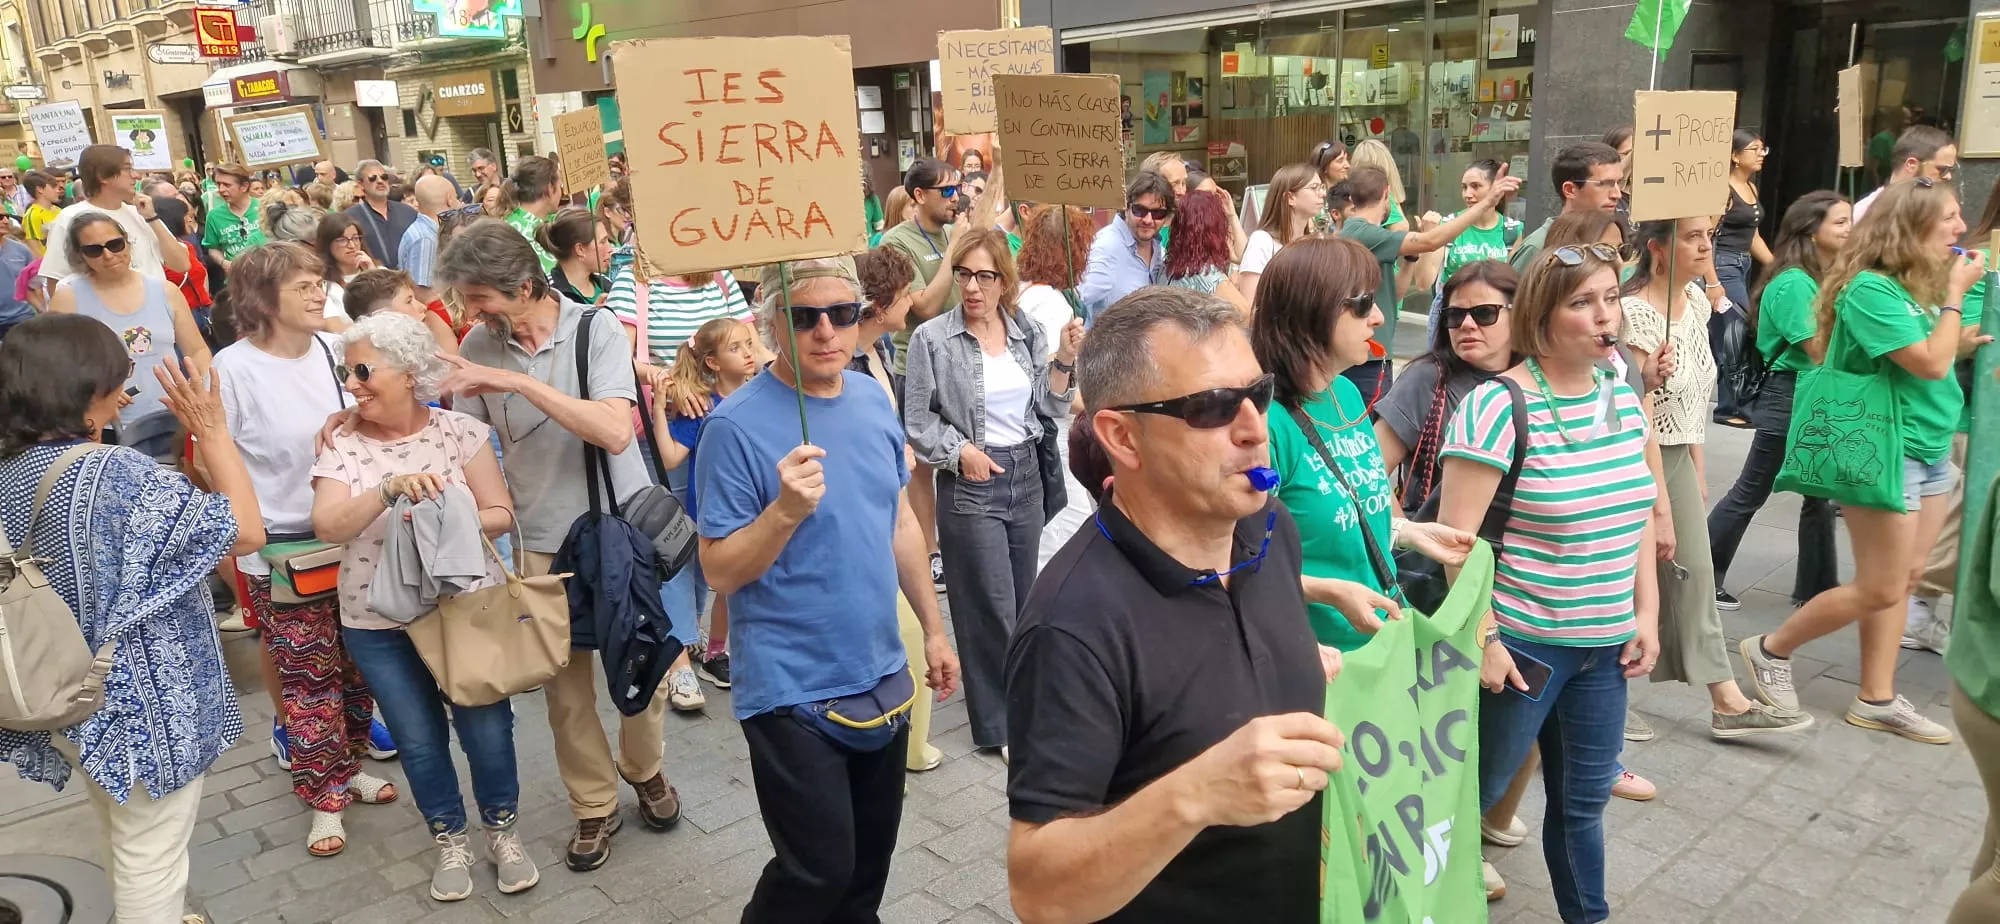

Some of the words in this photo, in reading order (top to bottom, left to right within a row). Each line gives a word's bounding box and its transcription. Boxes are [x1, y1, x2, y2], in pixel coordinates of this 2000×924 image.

[205, 45, 238, 55] 18:19
[948, 38, 1055, 58] NECESITAMOS
[968, 59, 999, 80] MÁS
[1007, 59, 1044, 74] AULAS
[247, 79, 276, 94] TABACOS
[439, 83, 486, 98] CUARZOS
[683, 68, 786, 104] IES
[1039, 90, 1071, 111] MÁS
[1077, 93, 1121, 118] CLASES
[31, 110, 59, 121] PLANTA
[40, 121, 74, 133] ESCUELA
[1004, 120, 1021, 134] EN
[1674, 113, 1732, 146] PROFES
[658, 111, 845, 168] SIERRA
[1016, 150, 1050, 166] IES
[1056, 149, 1110, 168] SIERRA
[733, 176, 774, 206] DE
[1024, 174, 1043, 189] DE
[1057, 173, 1113, 190] GUARA
[670, 201, 834, 247] GUARA
